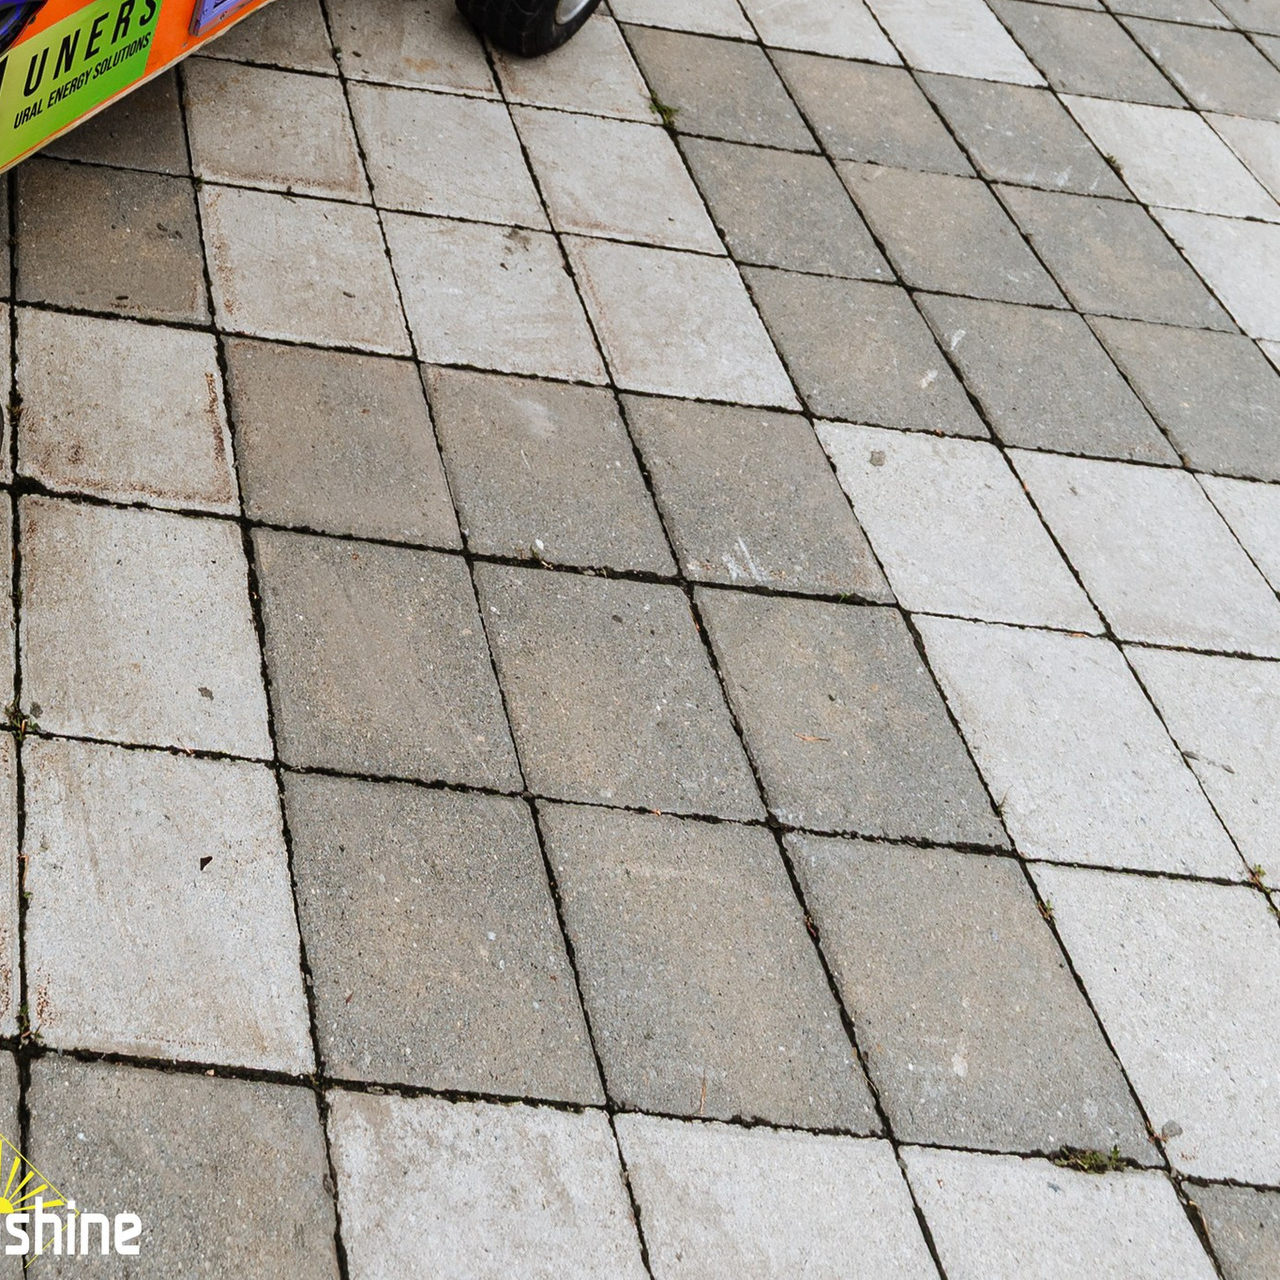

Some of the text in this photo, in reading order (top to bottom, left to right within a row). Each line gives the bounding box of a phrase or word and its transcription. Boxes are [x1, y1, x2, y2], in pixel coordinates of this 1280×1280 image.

[13, 31, 152, 130] URAL ENERGY SOLUTIONS
